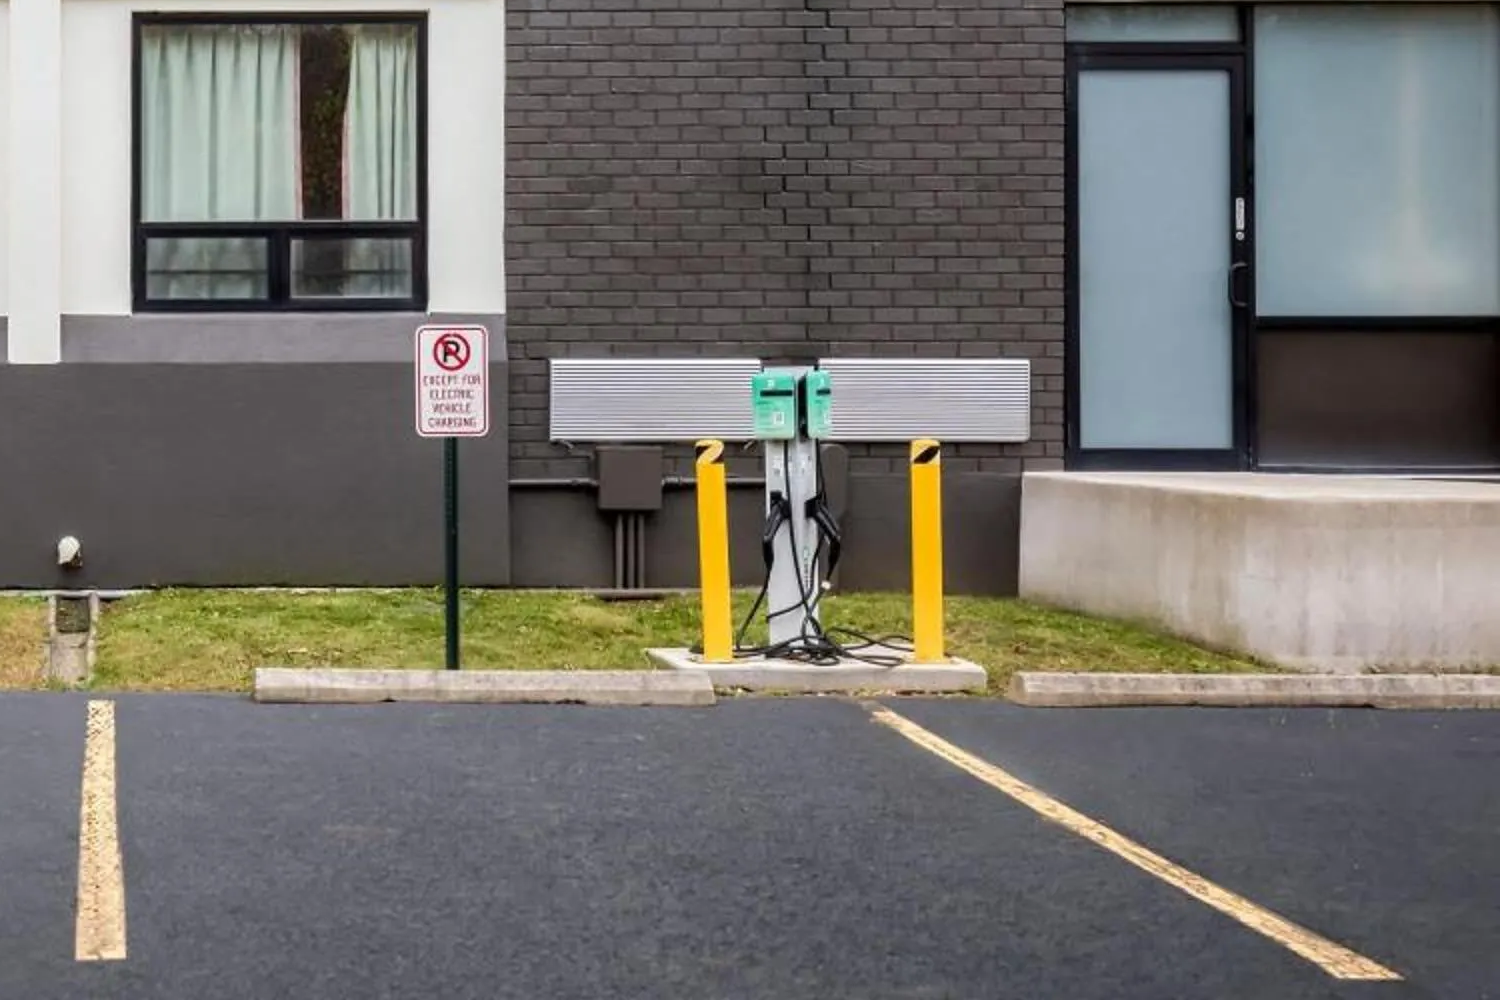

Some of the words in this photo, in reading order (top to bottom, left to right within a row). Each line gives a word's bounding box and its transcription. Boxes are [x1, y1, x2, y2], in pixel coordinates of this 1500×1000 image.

[423, 375, 459, 386] EXCEPT
[461, 375, 481, 386] FOR
[429, 389, 475, 401] ELECTRIC
[432, 402, 472, 413] VEHICLE
[427, 417, 477, 428] CHARGING
